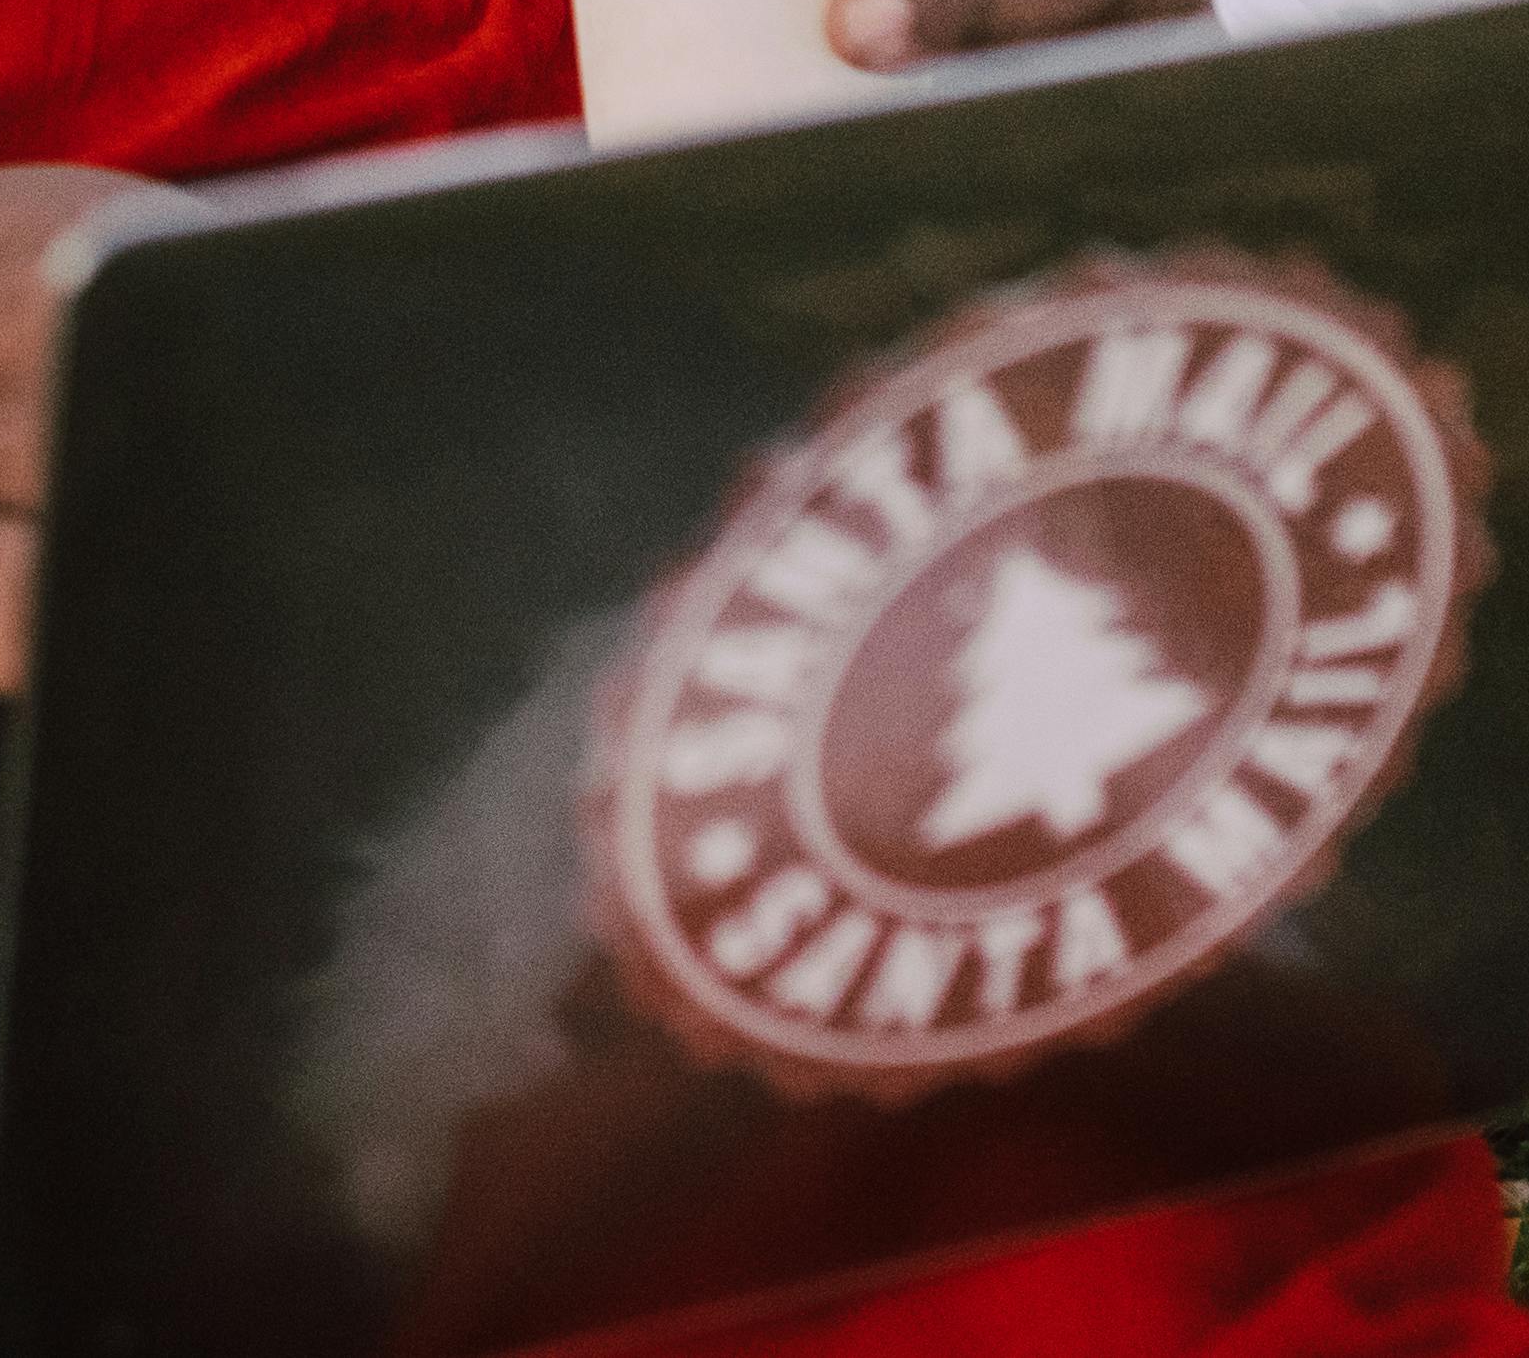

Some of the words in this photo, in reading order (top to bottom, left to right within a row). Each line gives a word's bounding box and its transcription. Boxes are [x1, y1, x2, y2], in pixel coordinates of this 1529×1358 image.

[664, 382, 1028, 795] SANTA
[1074, 327, 1379, 516] MAIL
[709, 869, 1128, 1028] SANTA
[1162, 583, 1418, 896] MAIL
